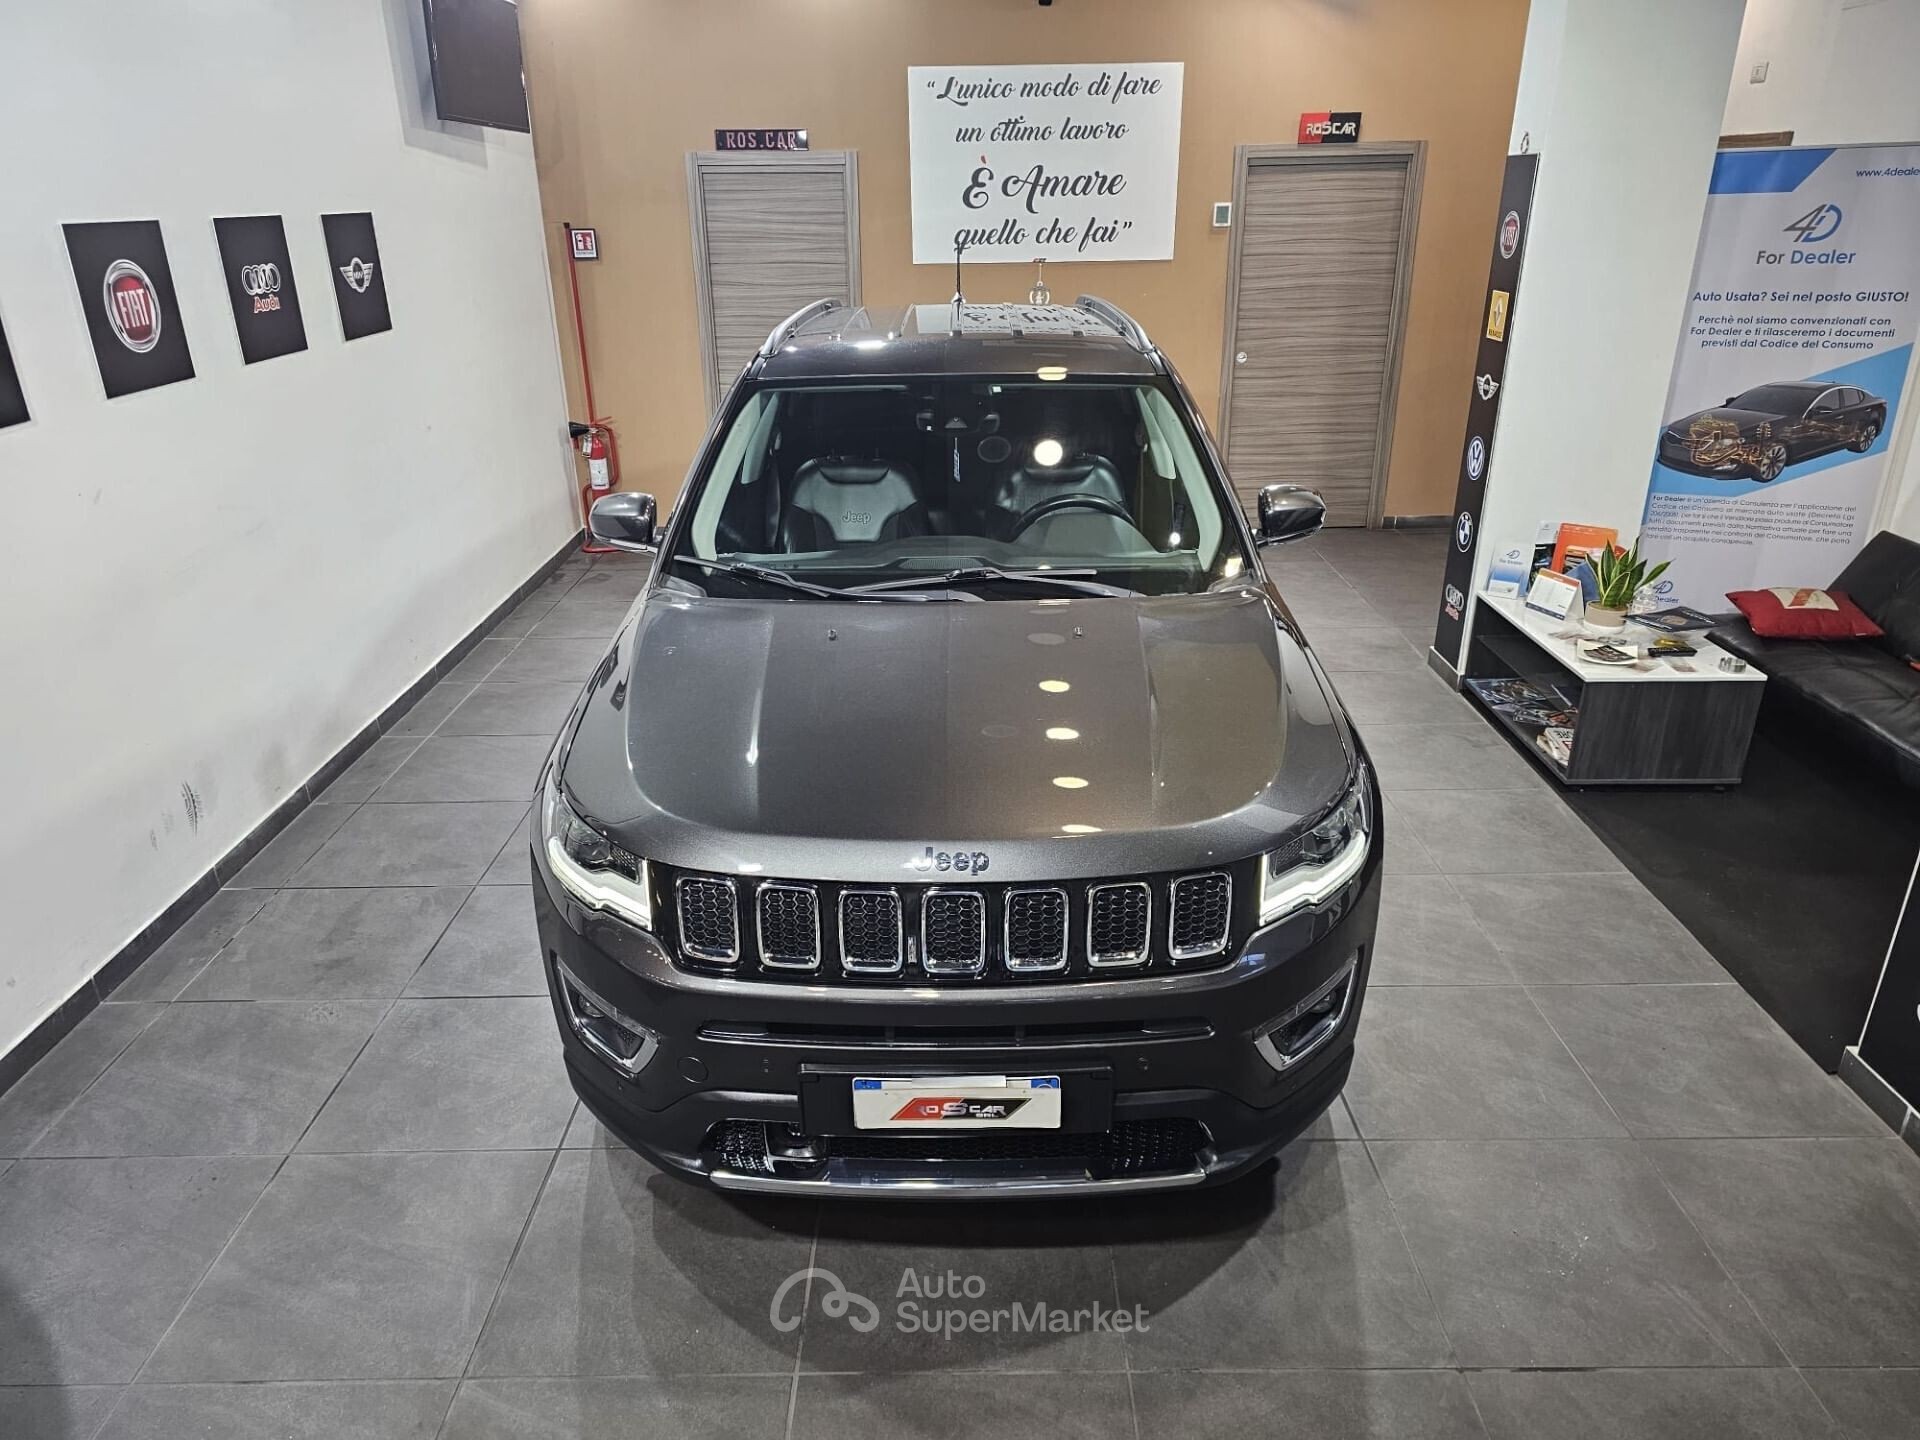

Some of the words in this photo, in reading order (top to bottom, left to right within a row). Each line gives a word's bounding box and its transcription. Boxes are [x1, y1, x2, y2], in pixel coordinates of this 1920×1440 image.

[1020, 73, 1081, 98] modo
[1087, 72, 1112, 96] di
[1112, 71, 1162, 104] fare
[955, 125, 985, 143] un
[990, 115, 1055, 142] ottimo
[1060, 117, 1129, 140] lavoro
[1306, 121, 1356, 136] ROSCAR
[962, 155, 994, 209] È
[1001, 164, 1127, 214] Amare
[954, 218, 1030, 254] quello
[1036, 218, 1078, 244] che
[1756, 250, 1785, 264] For
[1790, 249, 1857, 264] Dealer
[254, 295, 281, 314] Audi
[1693, 291, 1722, 301] Auto
[1726, 291, 1768, 302] Usata?
[1771, 291, 1789, 302] Sei
[1792, 292, 1812, 302] nel
[1815, 292, 1852, 304] posto
[1855, 291, 1909, 302] GIUSTO!
[116, 288, 150, 329] FIAT
[1737, 316, 1753, 324] noi
[1755, 316, 1787, 325] siamo
[1790, 316, 1867, 326] convenzionati
[1869, 318, 1891, 326] con
[1690, 327, 1705, 335] For
[1708, 327, 1742, 336] Dealer
[1754, 327, 1761, 336] ti
[1763, 328, 1826, 337] rilasceremo
[1835, 328, 1895, 338] documenti
[1701, 339, 1738, 349] previsti
[1740, 339, 1757, 348] dal
[1759, 339, 1799, 349] Codice
[1801, 340, 1819, 349] del
[1821, 340, 1874, 350] Consumo
[842, 511, 871, 524] Jeep
[911, 846, 990, 876] Jeep
